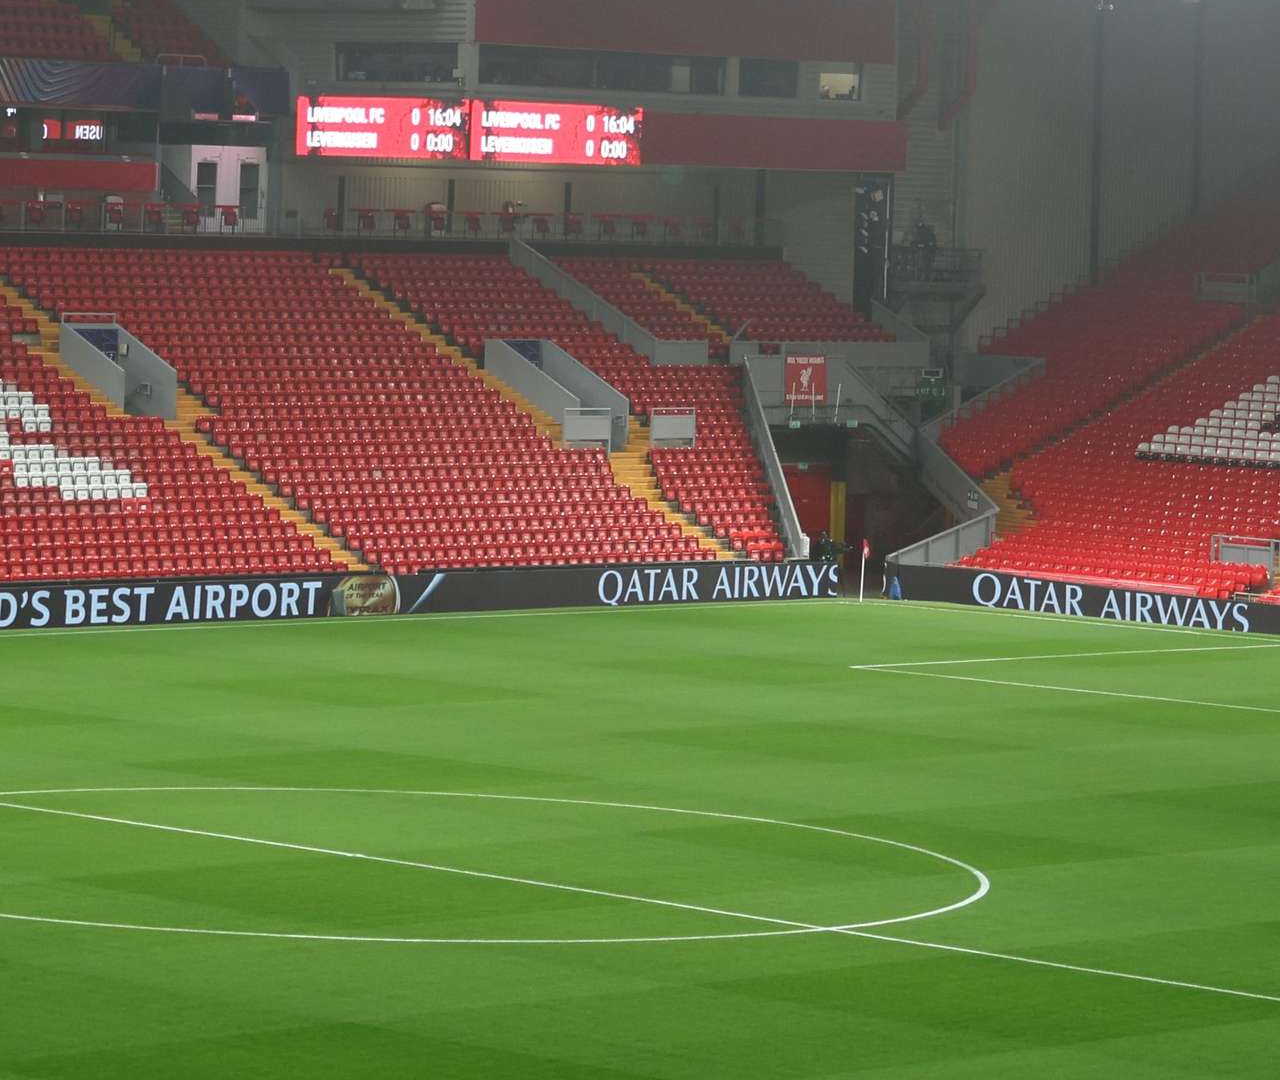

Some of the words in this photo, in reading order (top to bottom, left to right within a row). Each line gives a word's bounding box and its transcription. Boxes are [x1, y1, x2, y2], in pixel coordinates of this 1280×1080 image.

[411, 108, 420, 126] 0
[428, 108, 462, 127] 16:04
[586, 115, 595, 133] 0
[602, 115, 635, 134] 16:04
[410, 133, 420, 151] 0
[426, 134, 454, 152] 0:00
[585, 139, 595, 158] 0
[600, 141, 628, 159] 0:00
[598, 567, 700, 606] QATAR
[712, 564, 838, 599] AIRWAYS
[63, 586, 155, 625] BEST
[164, 581, 322, 621] AIRPORT
[972, 572, 1084, 616] QATAR
[1099, 590, 1251, 633] AIRWAYS
